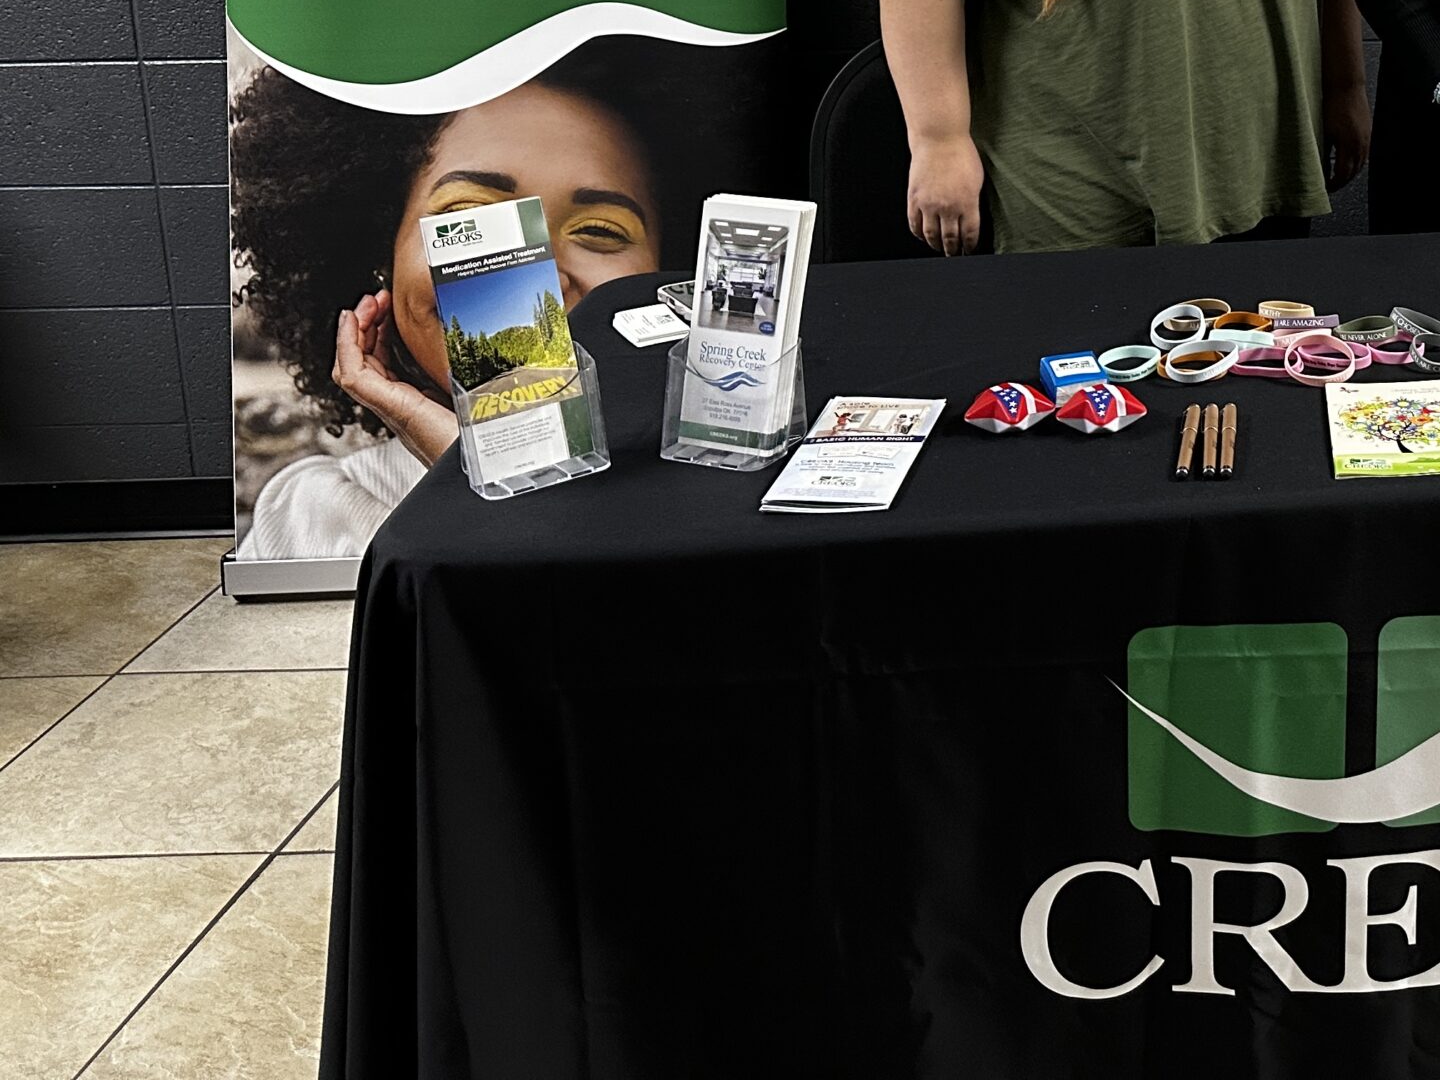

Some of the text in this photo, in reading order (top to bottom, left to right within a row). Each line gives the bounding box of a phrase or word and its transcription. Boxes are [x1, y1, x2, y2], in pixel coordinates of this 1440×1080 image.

[432, 230, 483, 249] CREOKS
[441, 245, 546, 274] Medication Assisted Treatment
[1292, 319, 1325, 327] AMAZING
[1367, 332, 1387, 340] ALONE
[700, 340, 767, 361] Spring Creek
[699, 353, 736, 369] Recovery
[470, 376, 578, 420] RECOVERY
